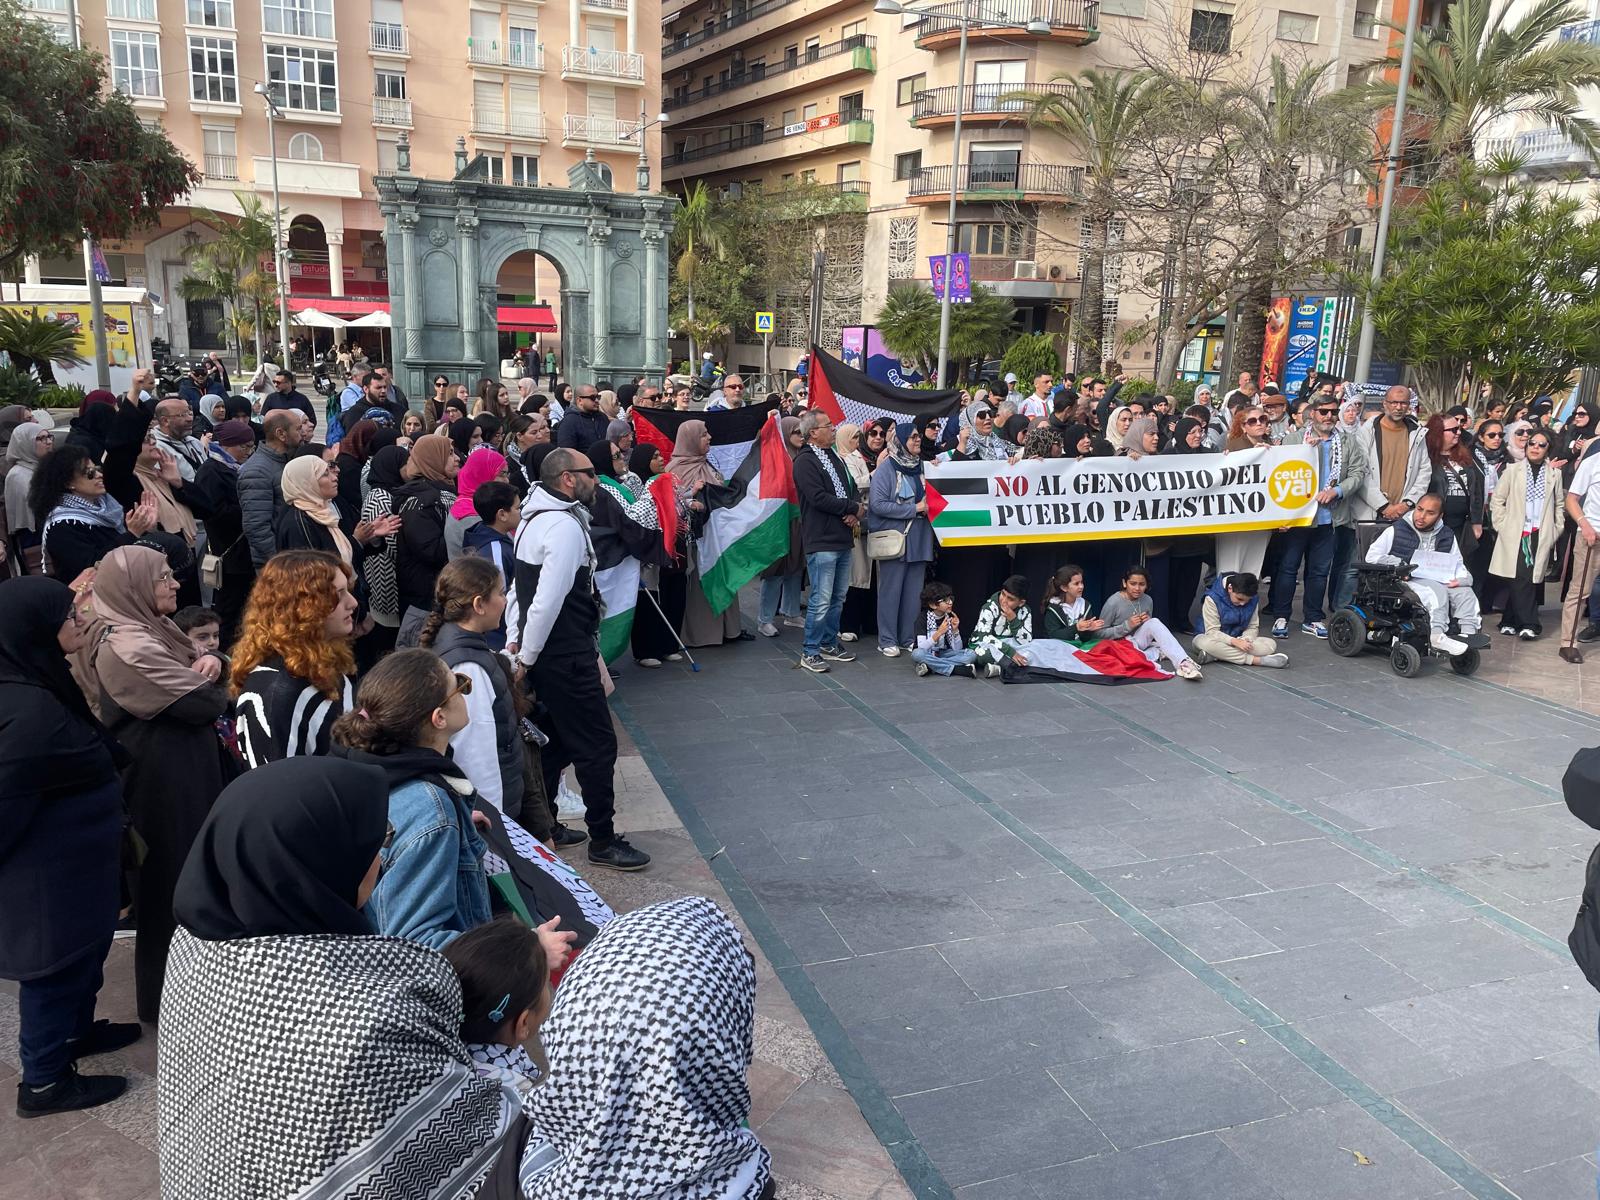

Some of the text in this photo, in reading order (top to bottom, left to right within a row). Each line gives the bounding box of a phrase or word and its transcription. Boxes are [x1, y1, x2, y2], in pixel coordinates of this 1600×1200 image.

[994, 463, 1266, 497] NO AL GENOCIDIO DEL
[1274, 467, 1313, 480] ceuta
[1274, 478, 1313, 503] ya!
[996, 491, 1266, 527] PUEBLO PALESTINO
